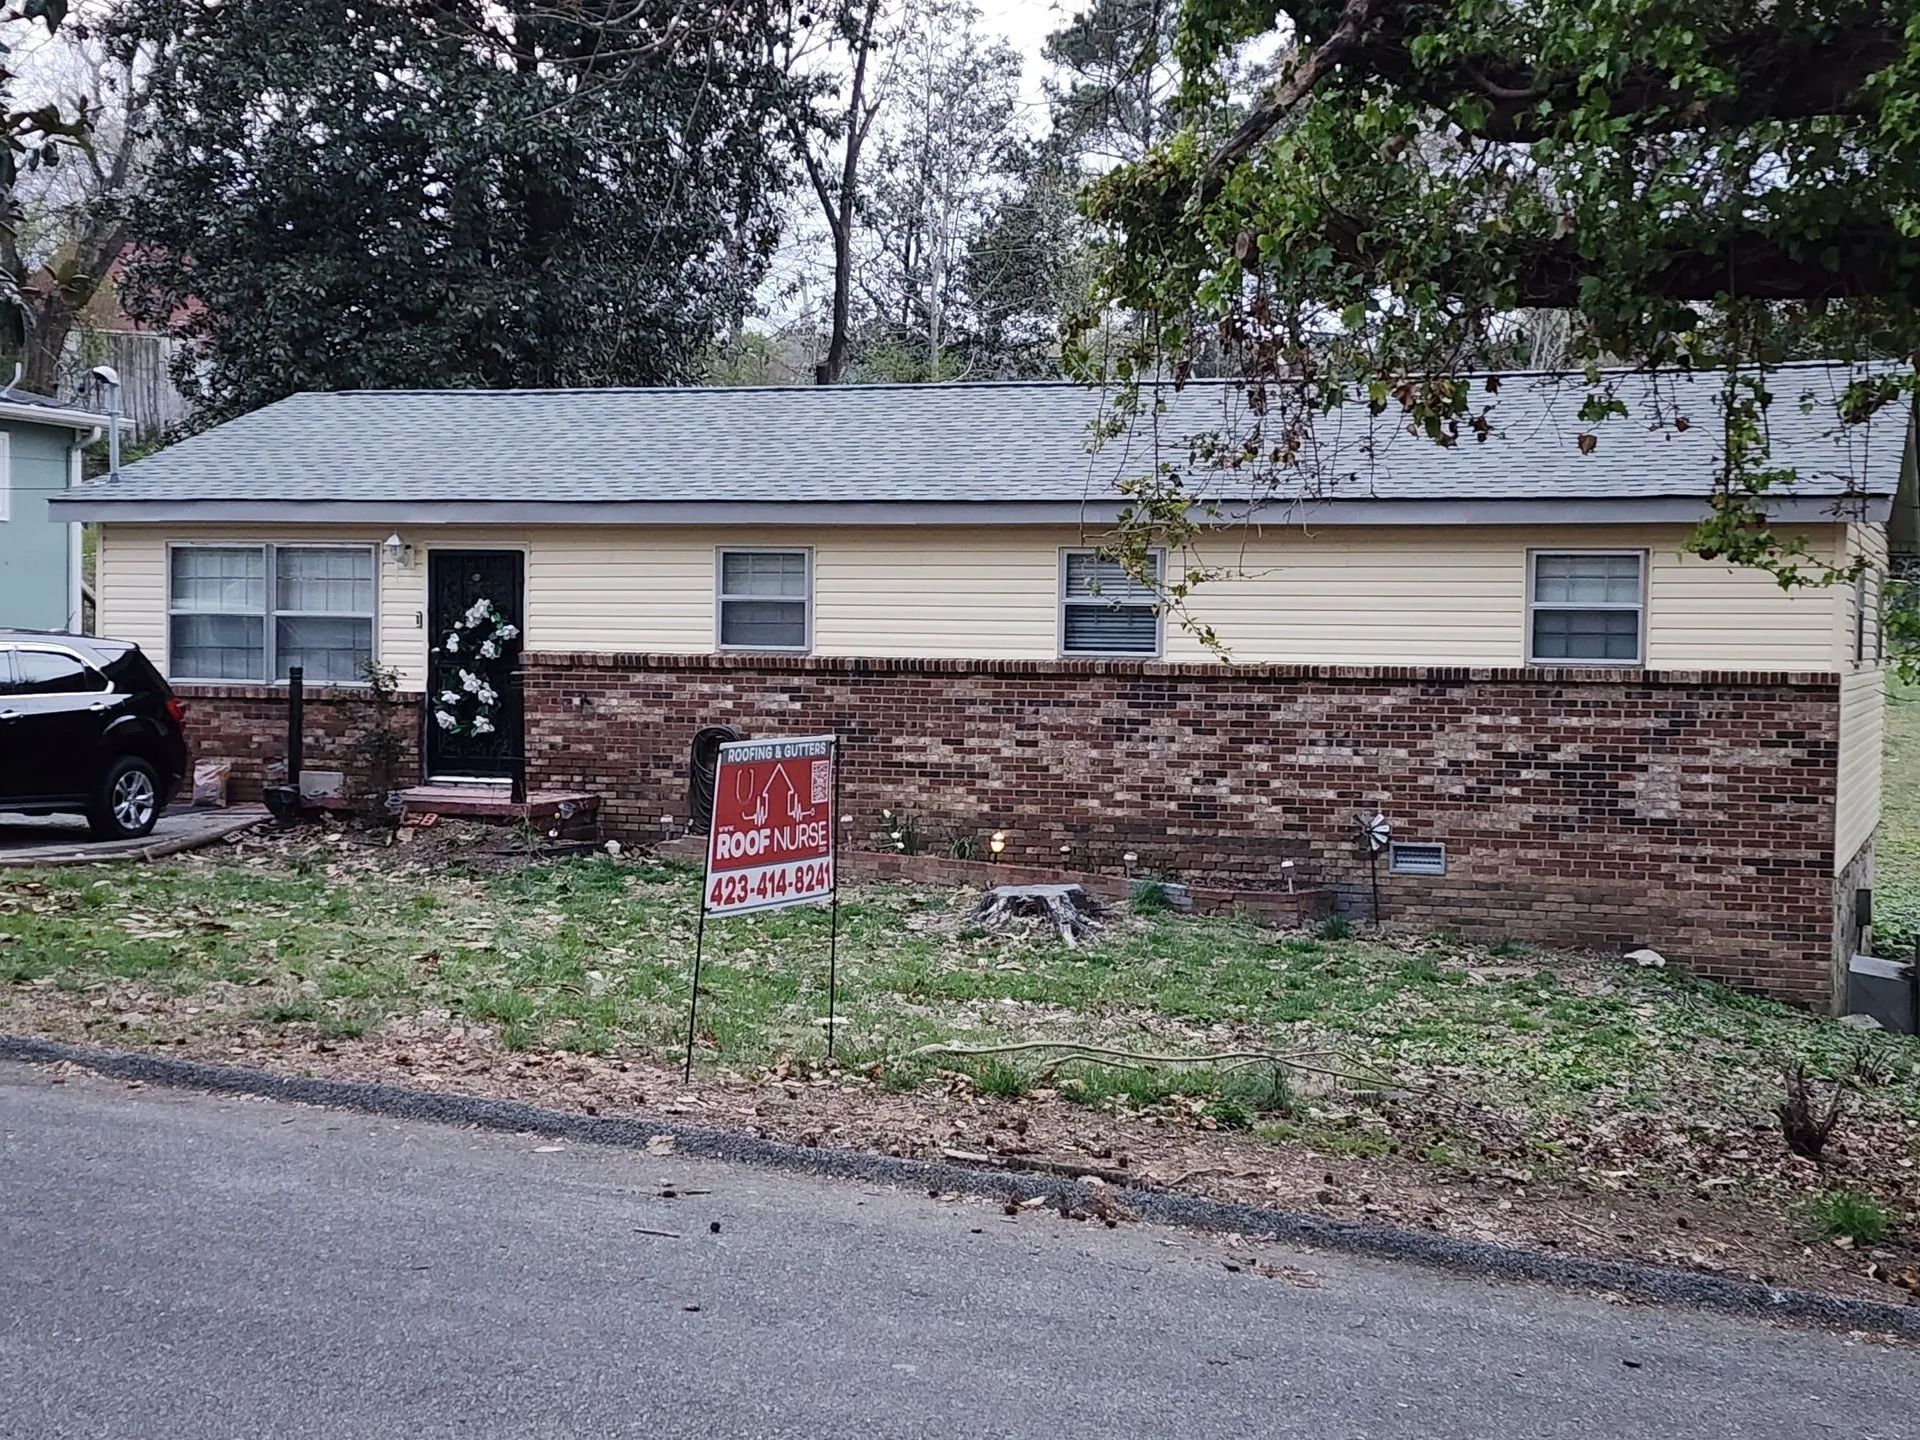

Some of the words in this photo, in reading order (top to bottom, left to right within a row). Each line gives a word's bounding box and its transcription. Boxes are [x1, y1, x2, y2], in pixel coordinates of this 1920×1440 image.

[728, 746, 773, 763] ROOFING
[775, 745, 782, 759] &
[784, 742, 827, 758] GUTTERS
[716, 828, 771, 860] ROOF
[774, 821, 827, 852] NURSE
[710, 861, 831, 906] 423-414-8241
